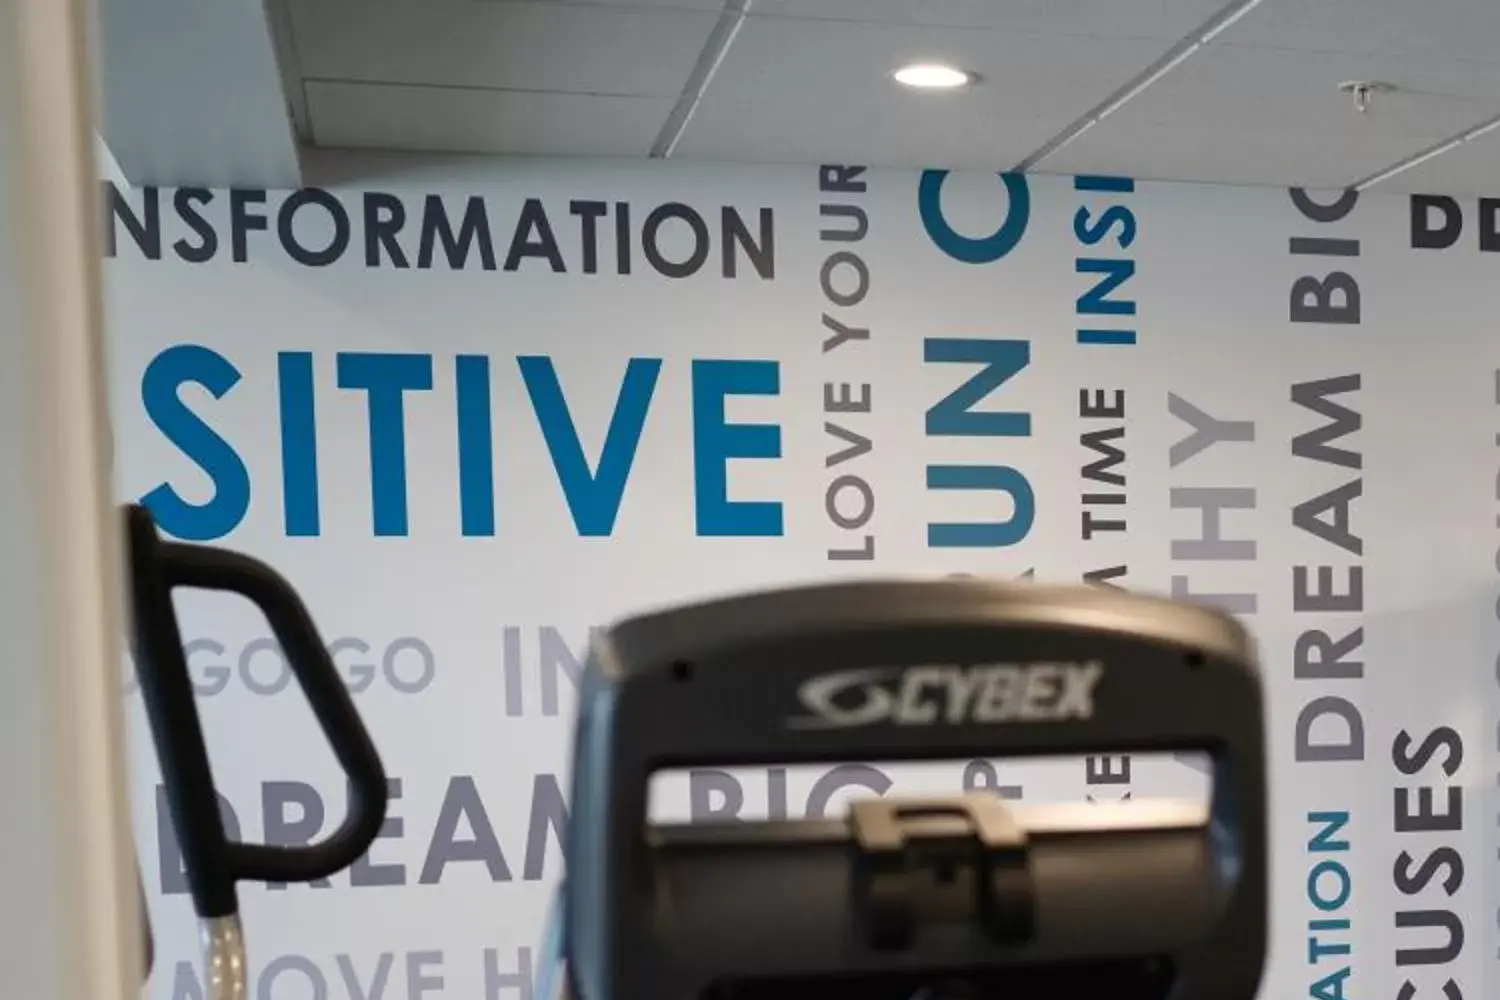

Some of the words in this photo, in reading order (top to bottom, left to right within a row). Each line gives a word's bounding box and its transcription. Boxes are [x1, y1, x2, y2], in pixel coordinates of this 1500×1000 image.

[101, 180, 775, 280] NSFORMATION
[819, 164, 870, 353] YOUR
[139, 344, 784, 541] SITIVE
[824, 383, 875, 560] LOVE
[924, 337, 1036, 582] UN
[1079, 388, 1127, 540] TIME
[1290, 373, 1365, 761] DREAM
[895, 659, 1104, 726] CYBEX
